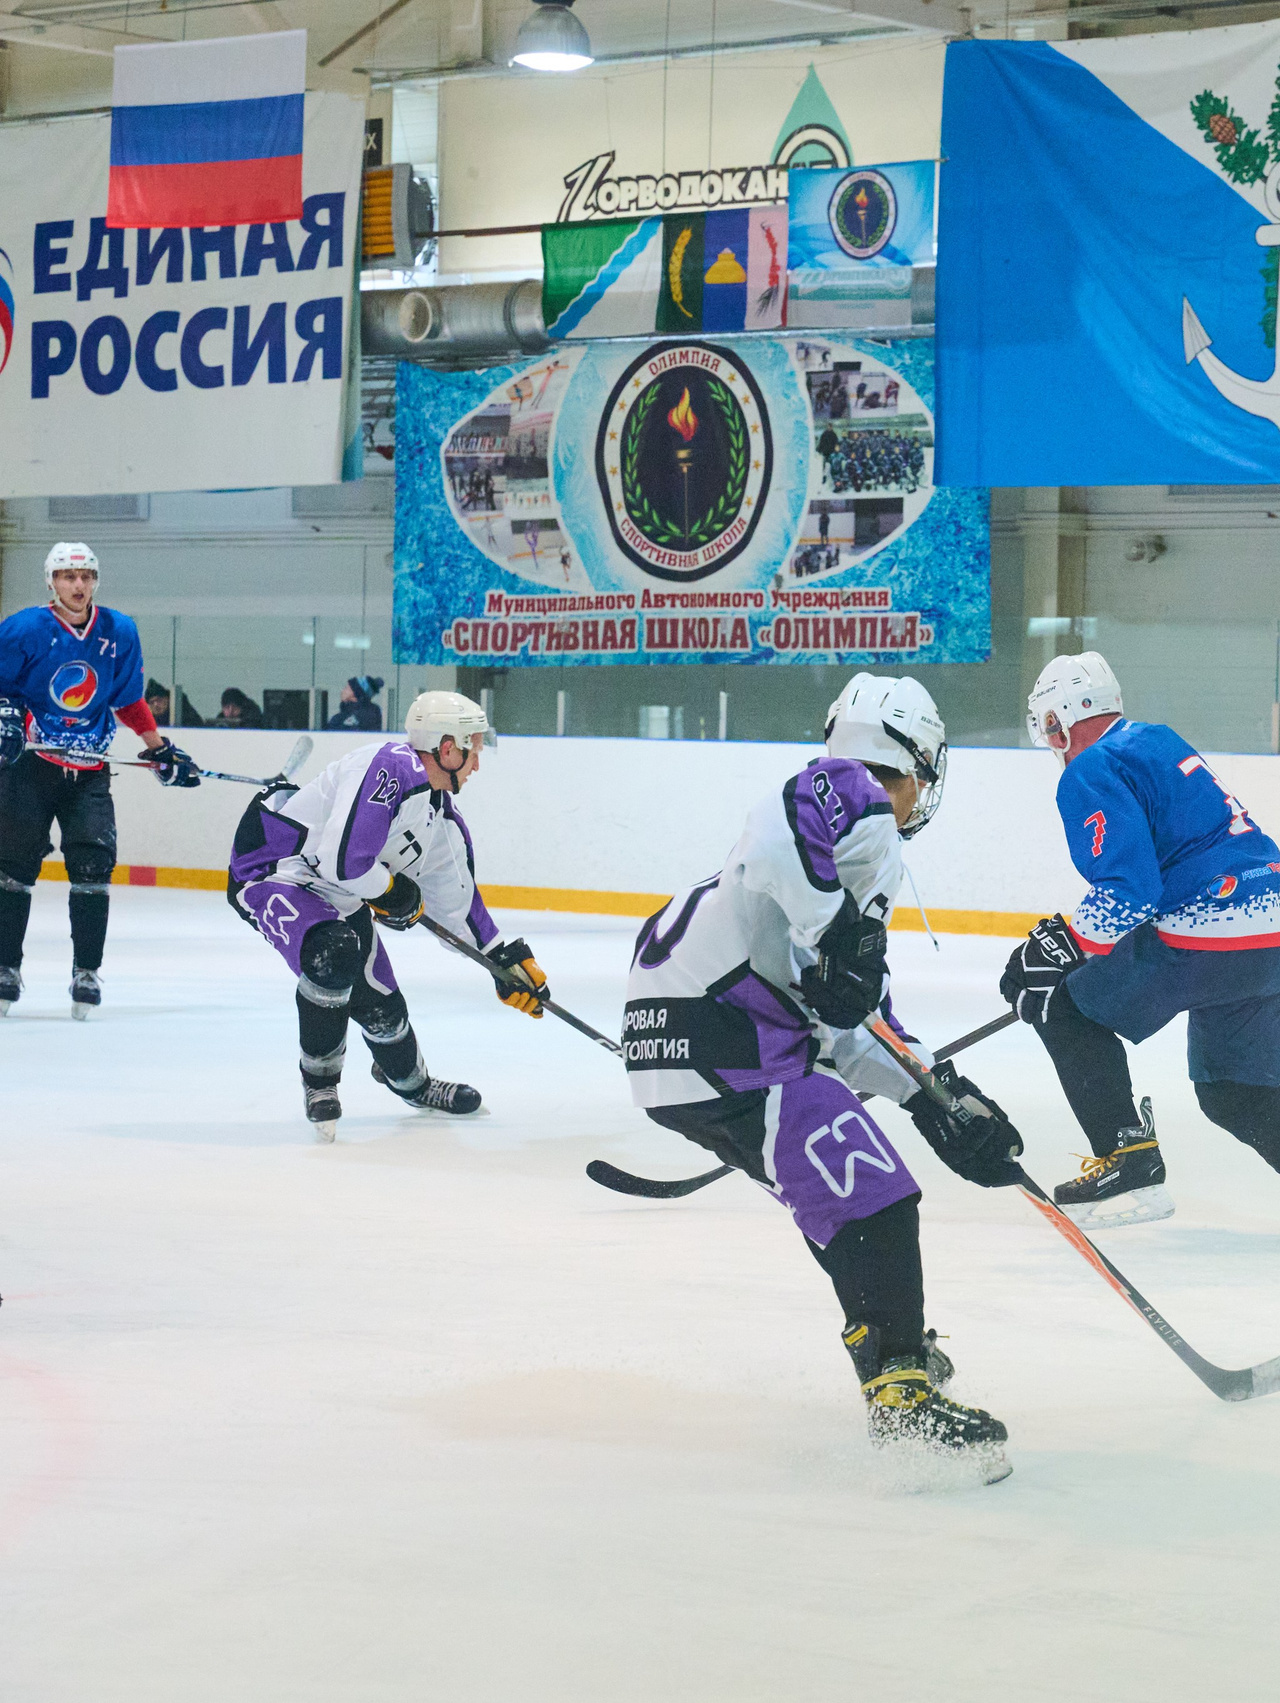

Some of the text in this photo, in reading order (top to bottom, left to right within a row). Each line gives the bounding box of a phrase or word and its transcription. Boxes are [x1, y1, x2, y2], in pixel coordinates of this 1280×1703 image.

[557, 149, 838, 224] ГОРВОДОКАН
[33, 191, 346, 301] ЕДИНАЯ
[31, 296, 344, 400] РОССИЯ
[648, 350, 722, 376] ОЛИМПИЯ
[620, 516, 748, 568] СПОРТИВНАЯ ШКОЛА
[488, 593, 636, 617] Муниципального
[641, 588, 764, 609] Автономного
[645, 616, 750, 650] ШКОЛА
[1084, 810, 1106, 857] 7
[1143, 1306, 1182, 1346] FLYLITE
